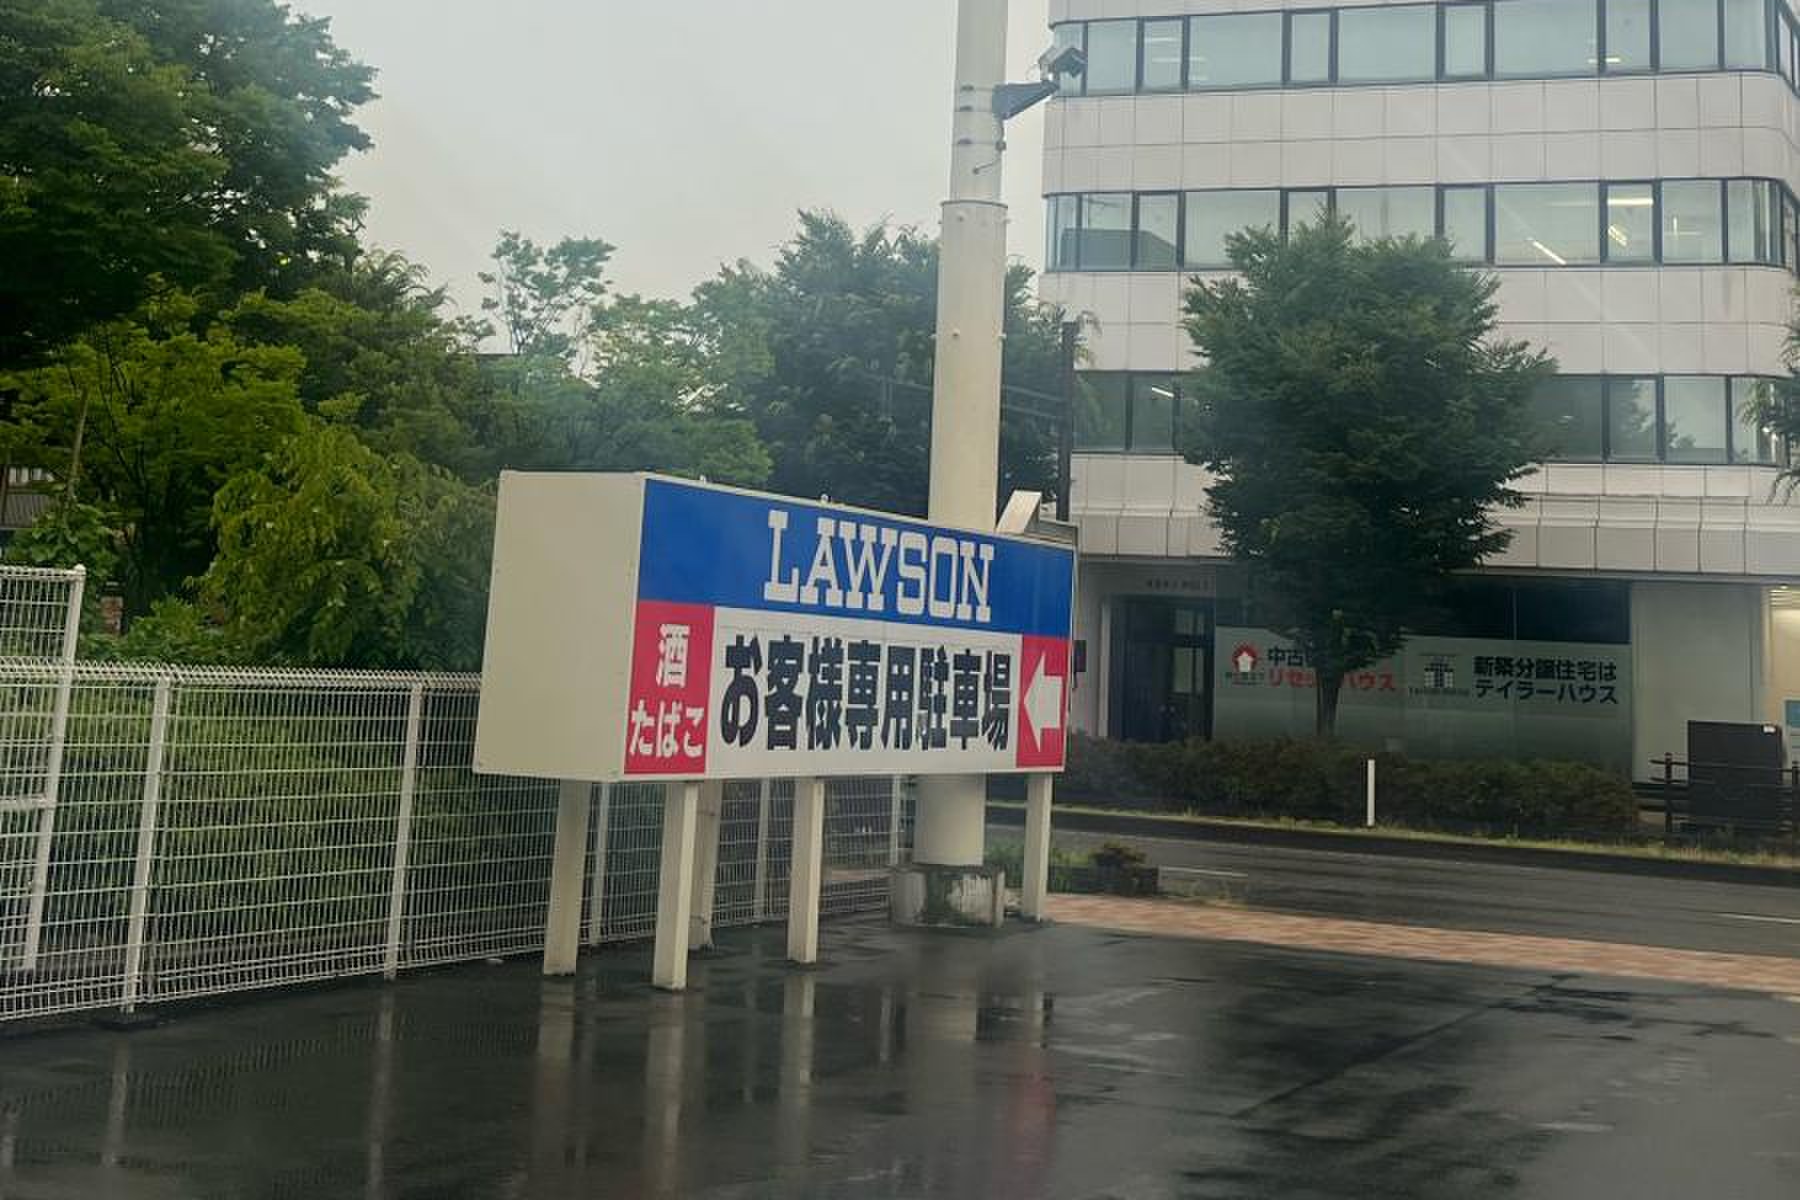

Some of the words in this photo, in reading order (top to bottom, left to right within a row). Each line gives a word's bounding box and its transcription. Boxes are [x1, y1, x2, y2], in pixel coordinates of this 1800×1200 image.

[764, 510, 994, 623] LAWSON
[656, 624, 690, 688] 酒
[720, 634, 1010, 751] お客様専用駐車場
[629, 699, 705, 758] たばこ
